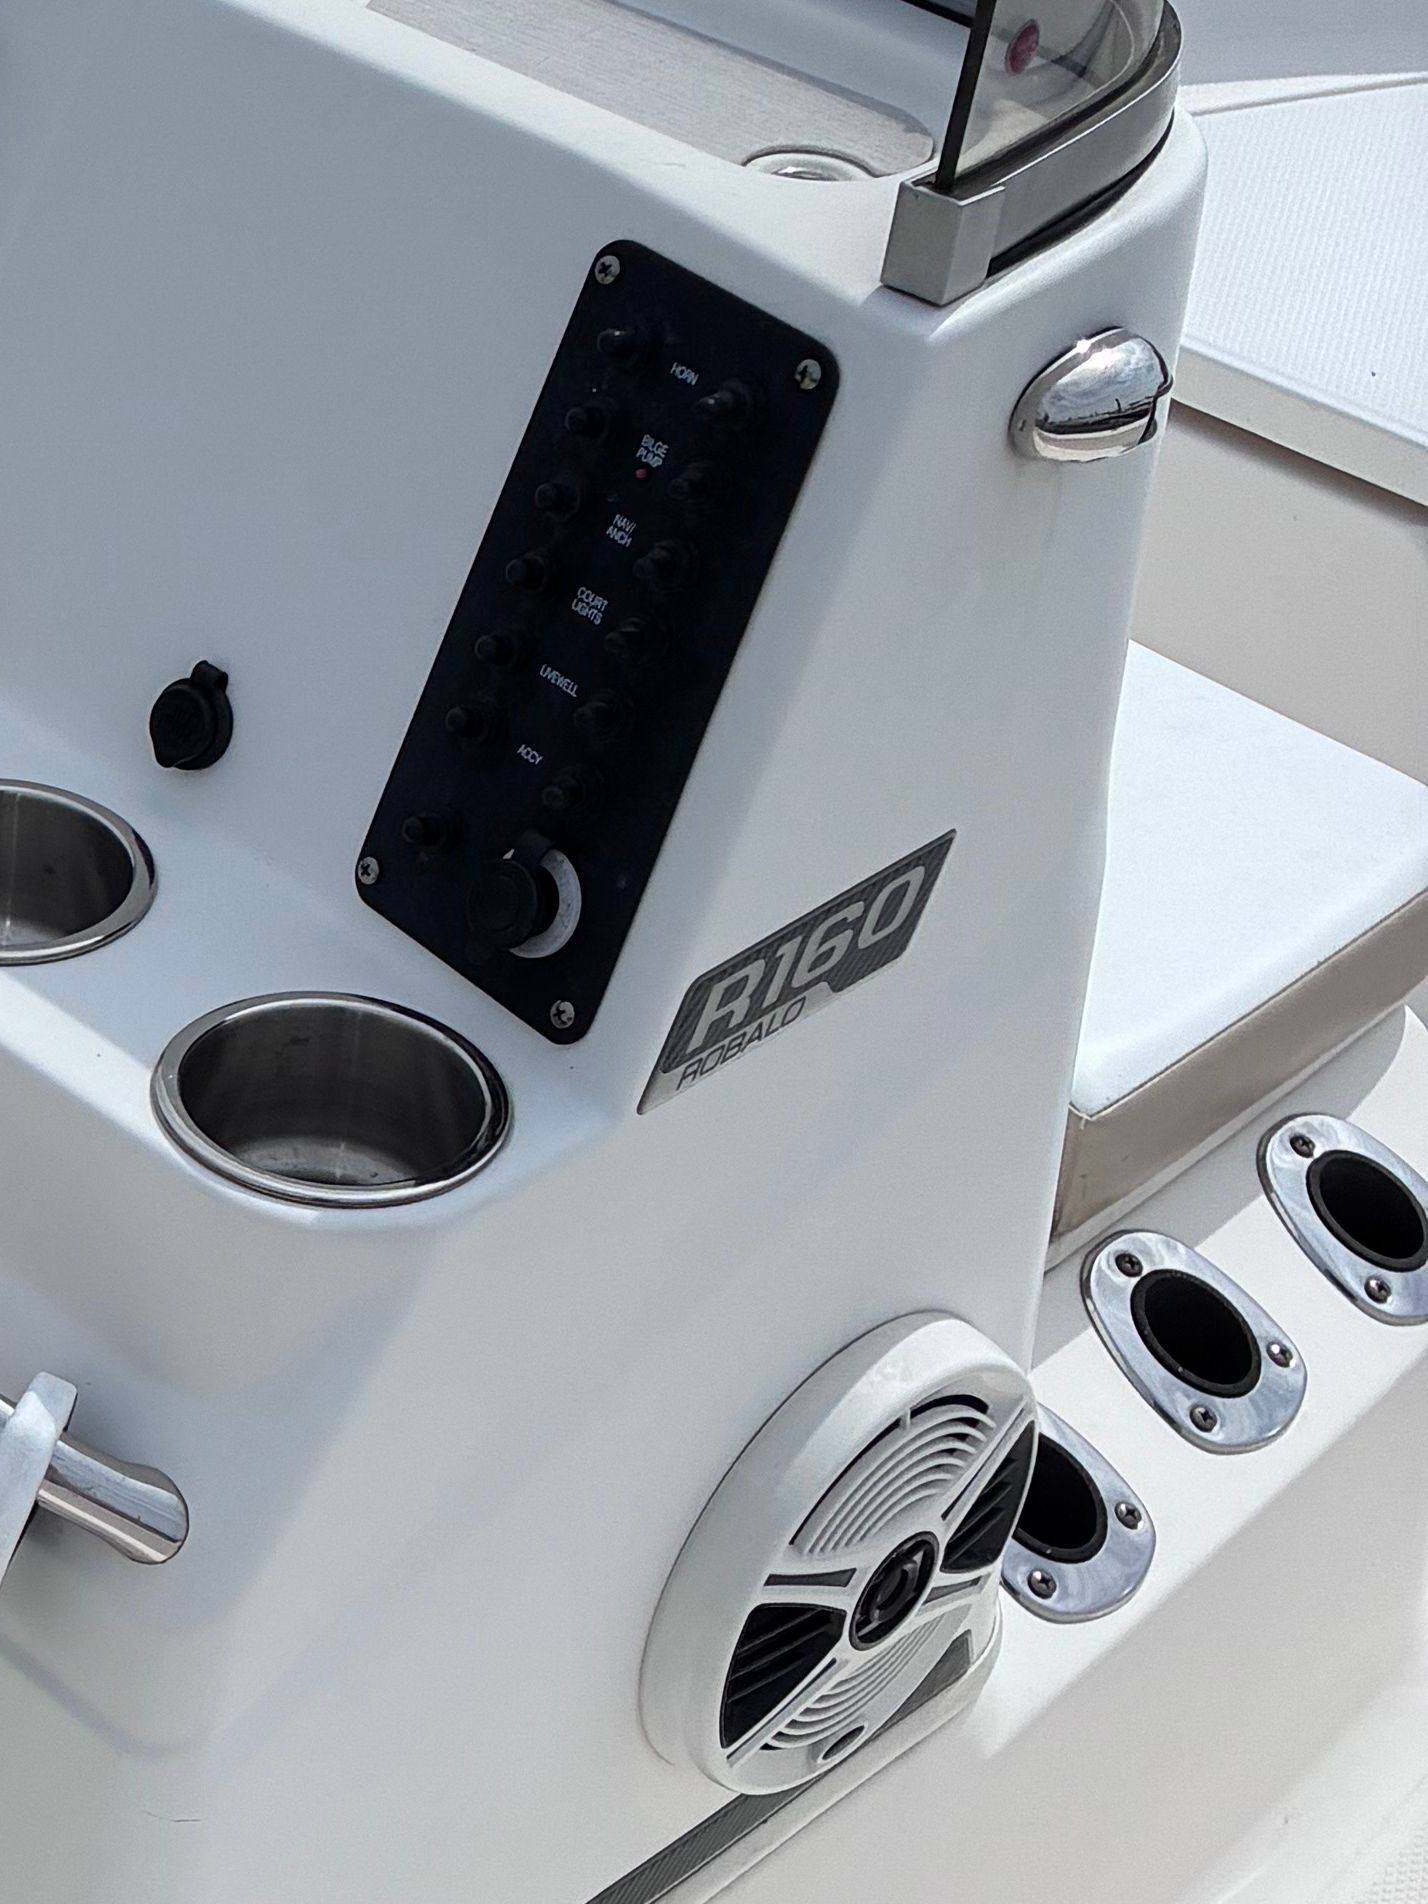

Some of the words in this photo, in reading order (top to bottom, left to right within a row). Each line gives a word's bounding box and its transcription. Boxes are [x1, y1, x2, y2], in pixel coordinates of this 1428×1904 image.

[669, 361, 700, 386] HORN
[635, 446, 664, 468] PUMP
[640, 433, 669, 459] BILGE
[605, 525, 633, 548] ANCH
[571, 597, 604, 626] LIGHTS
[576, 586, 609, 612] COURT
[539, 663, 580, 698] LIVEWELL
[516, 744, 544, 766] ACCY
[684, 864, 926, 1056] R160
[675, 996, 807, 1092] ROBALO
